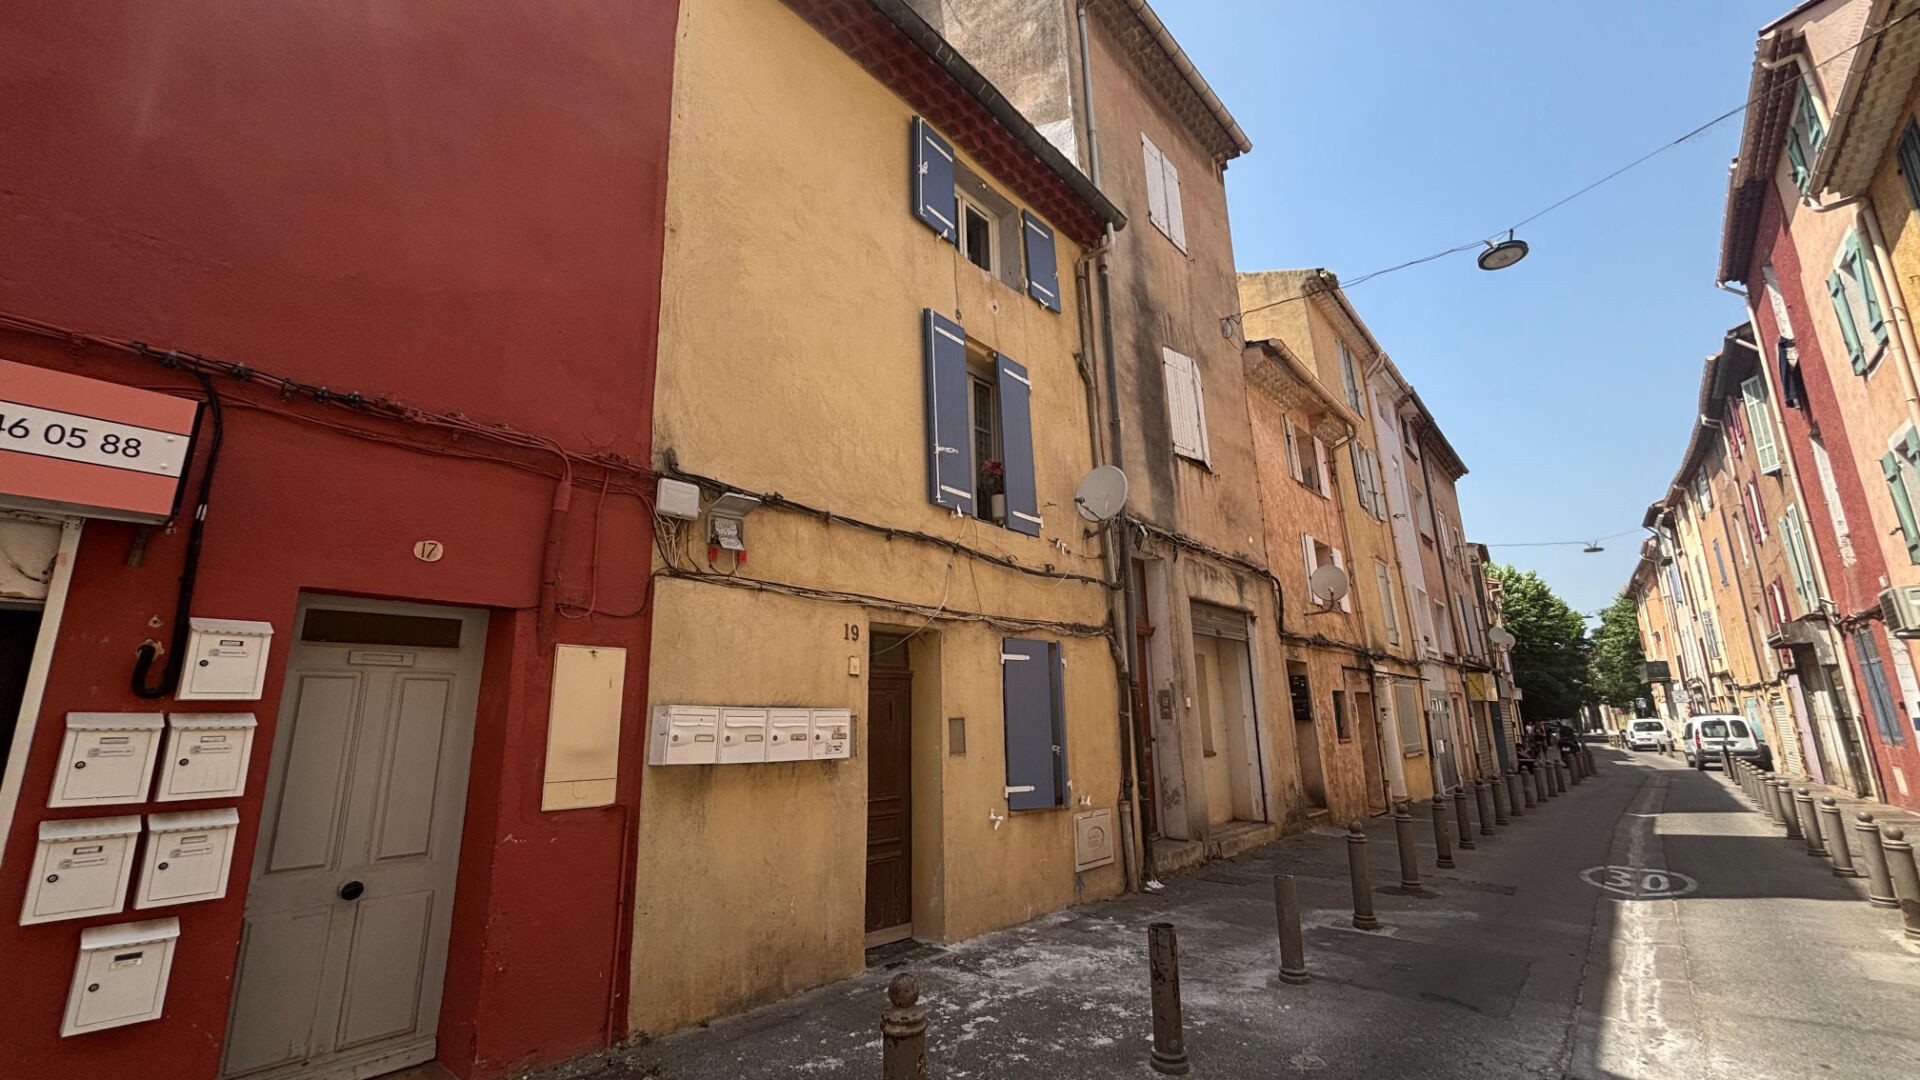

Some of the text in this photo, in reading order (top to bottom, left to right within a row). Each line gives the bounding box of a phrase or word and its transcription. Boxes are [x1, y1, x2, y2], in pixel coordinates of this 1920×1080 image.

[44, 424, 88, 448] 05
[100, 434, 142, 458] 88
[421, 542, 438, 558] 17
[843, 623, 860, 641] 19
[1604, 869, 1670, 891] 30
